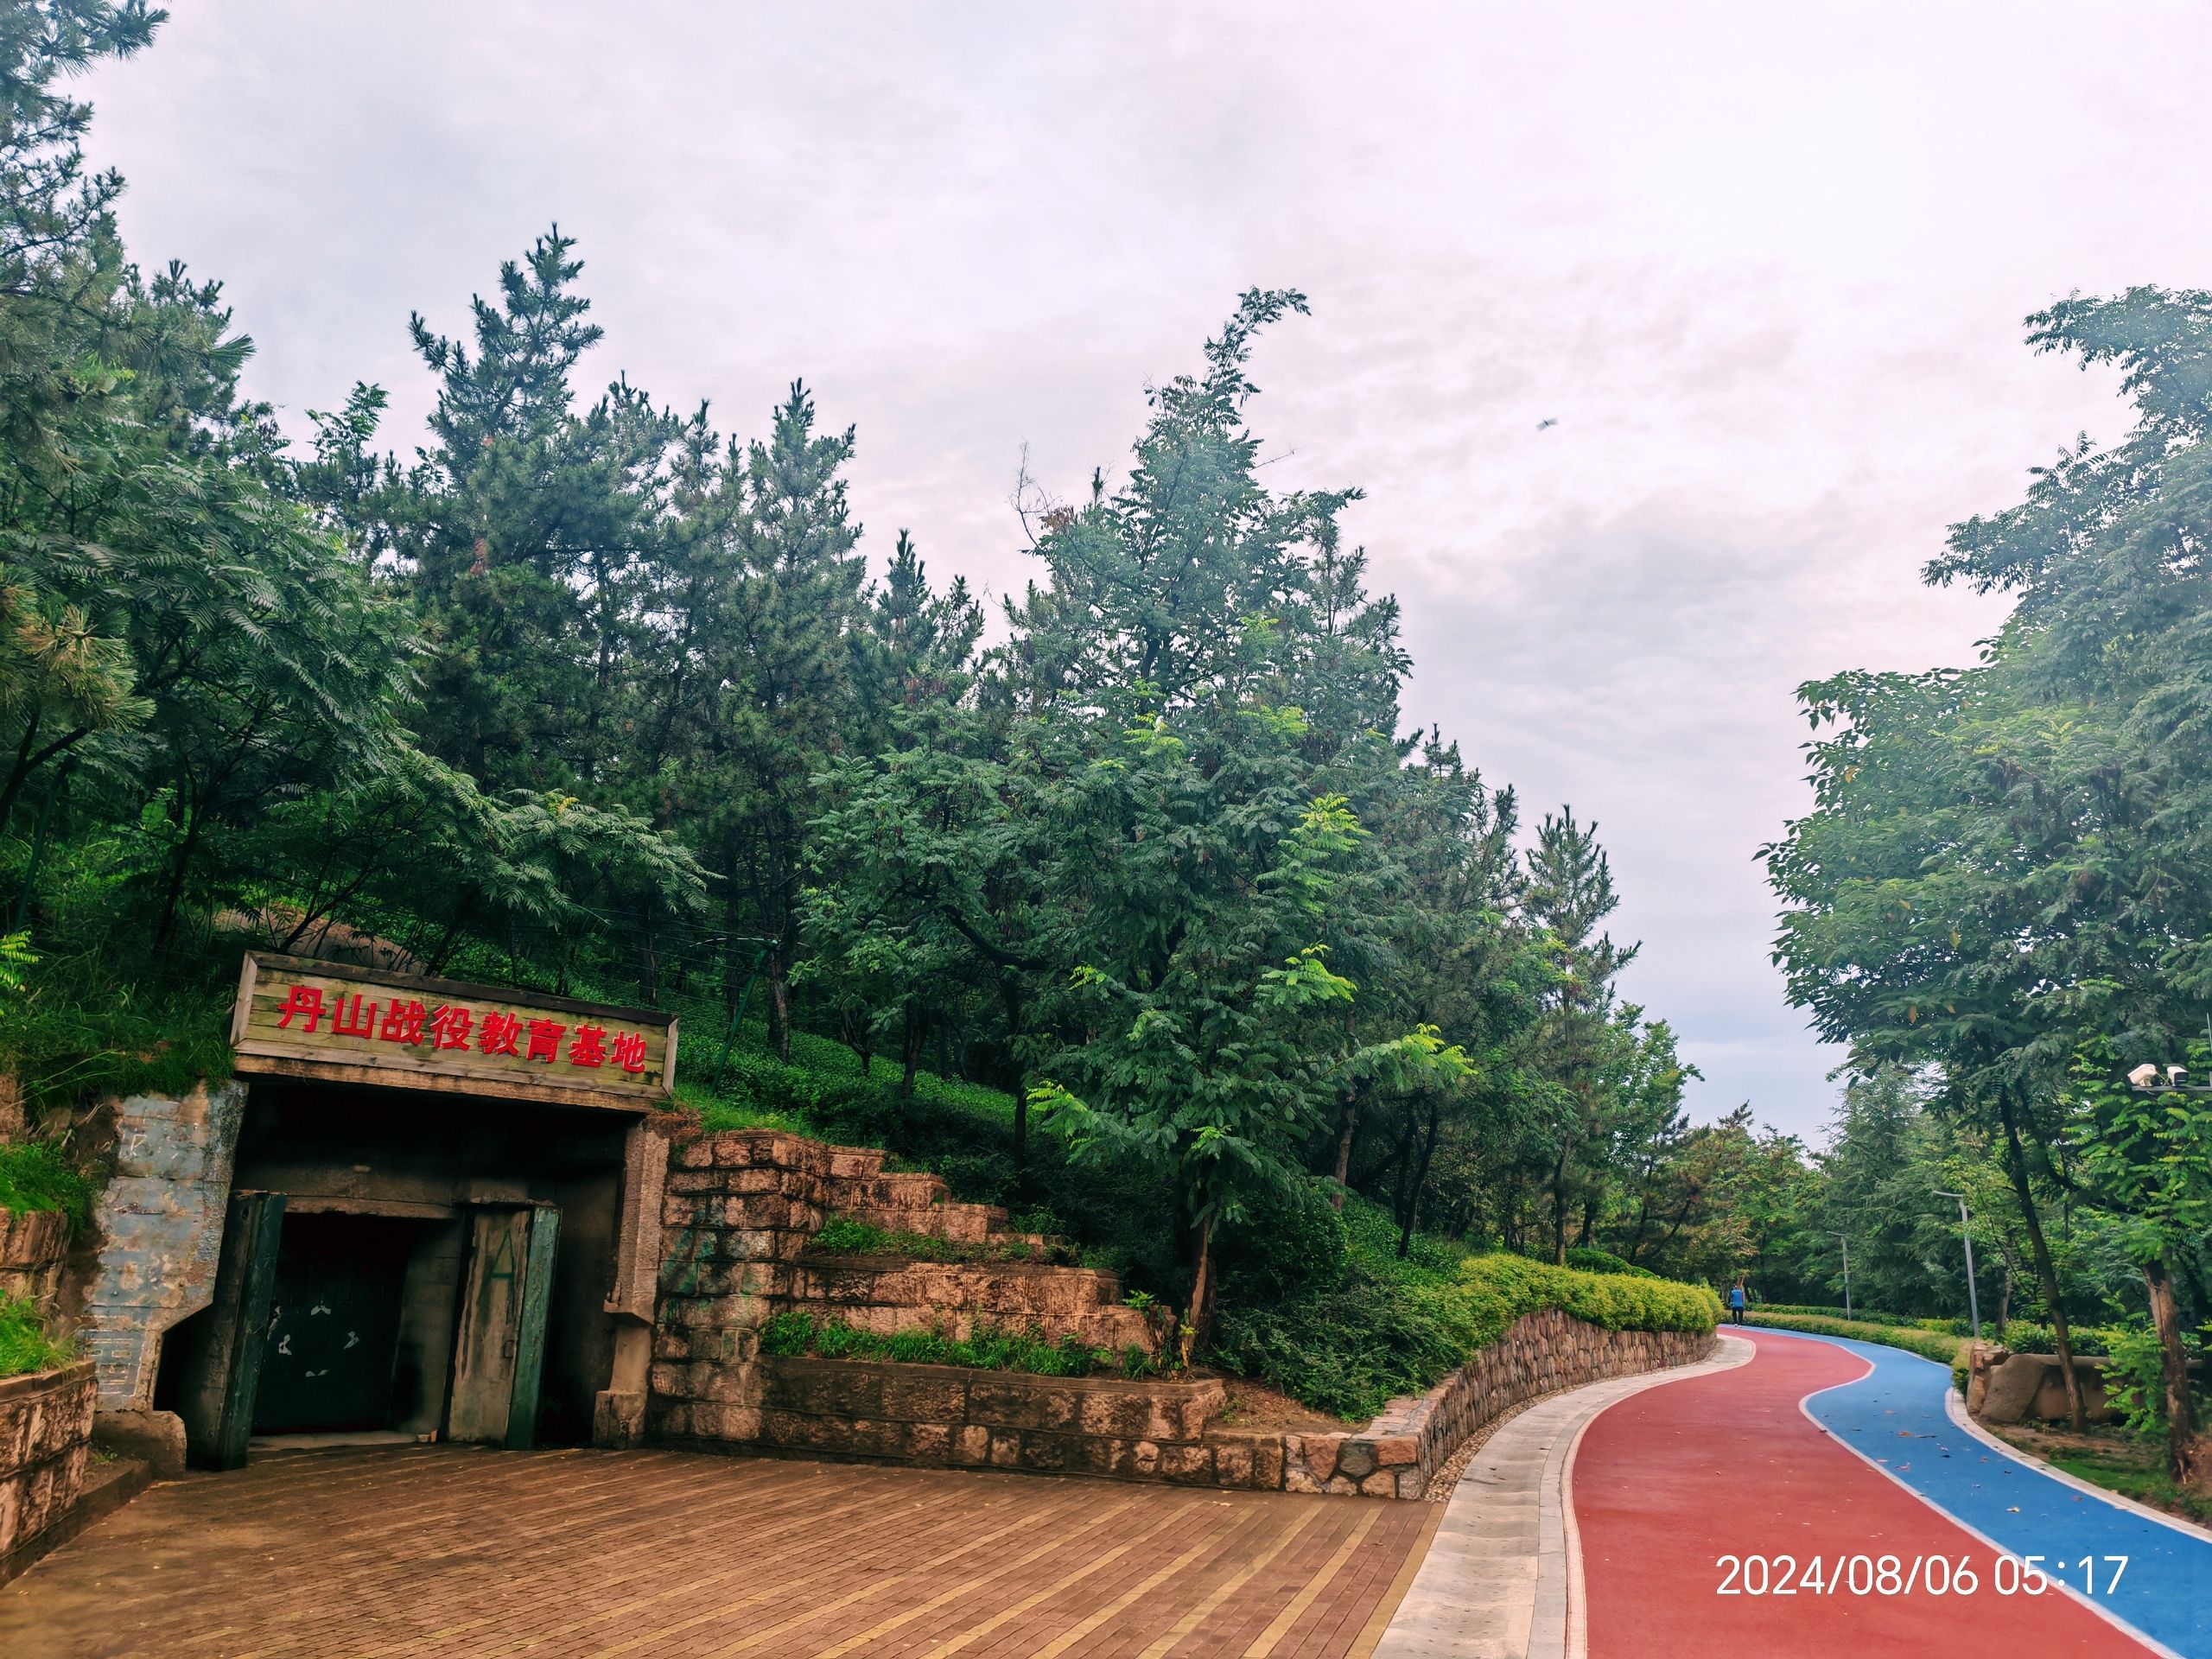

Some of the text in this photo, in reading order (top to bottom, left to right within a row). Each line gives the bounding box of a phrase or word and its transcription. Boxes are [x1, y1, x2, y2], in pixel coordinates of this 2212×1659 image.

[278, 985, 648, 1074] 丹山战役教育基地
